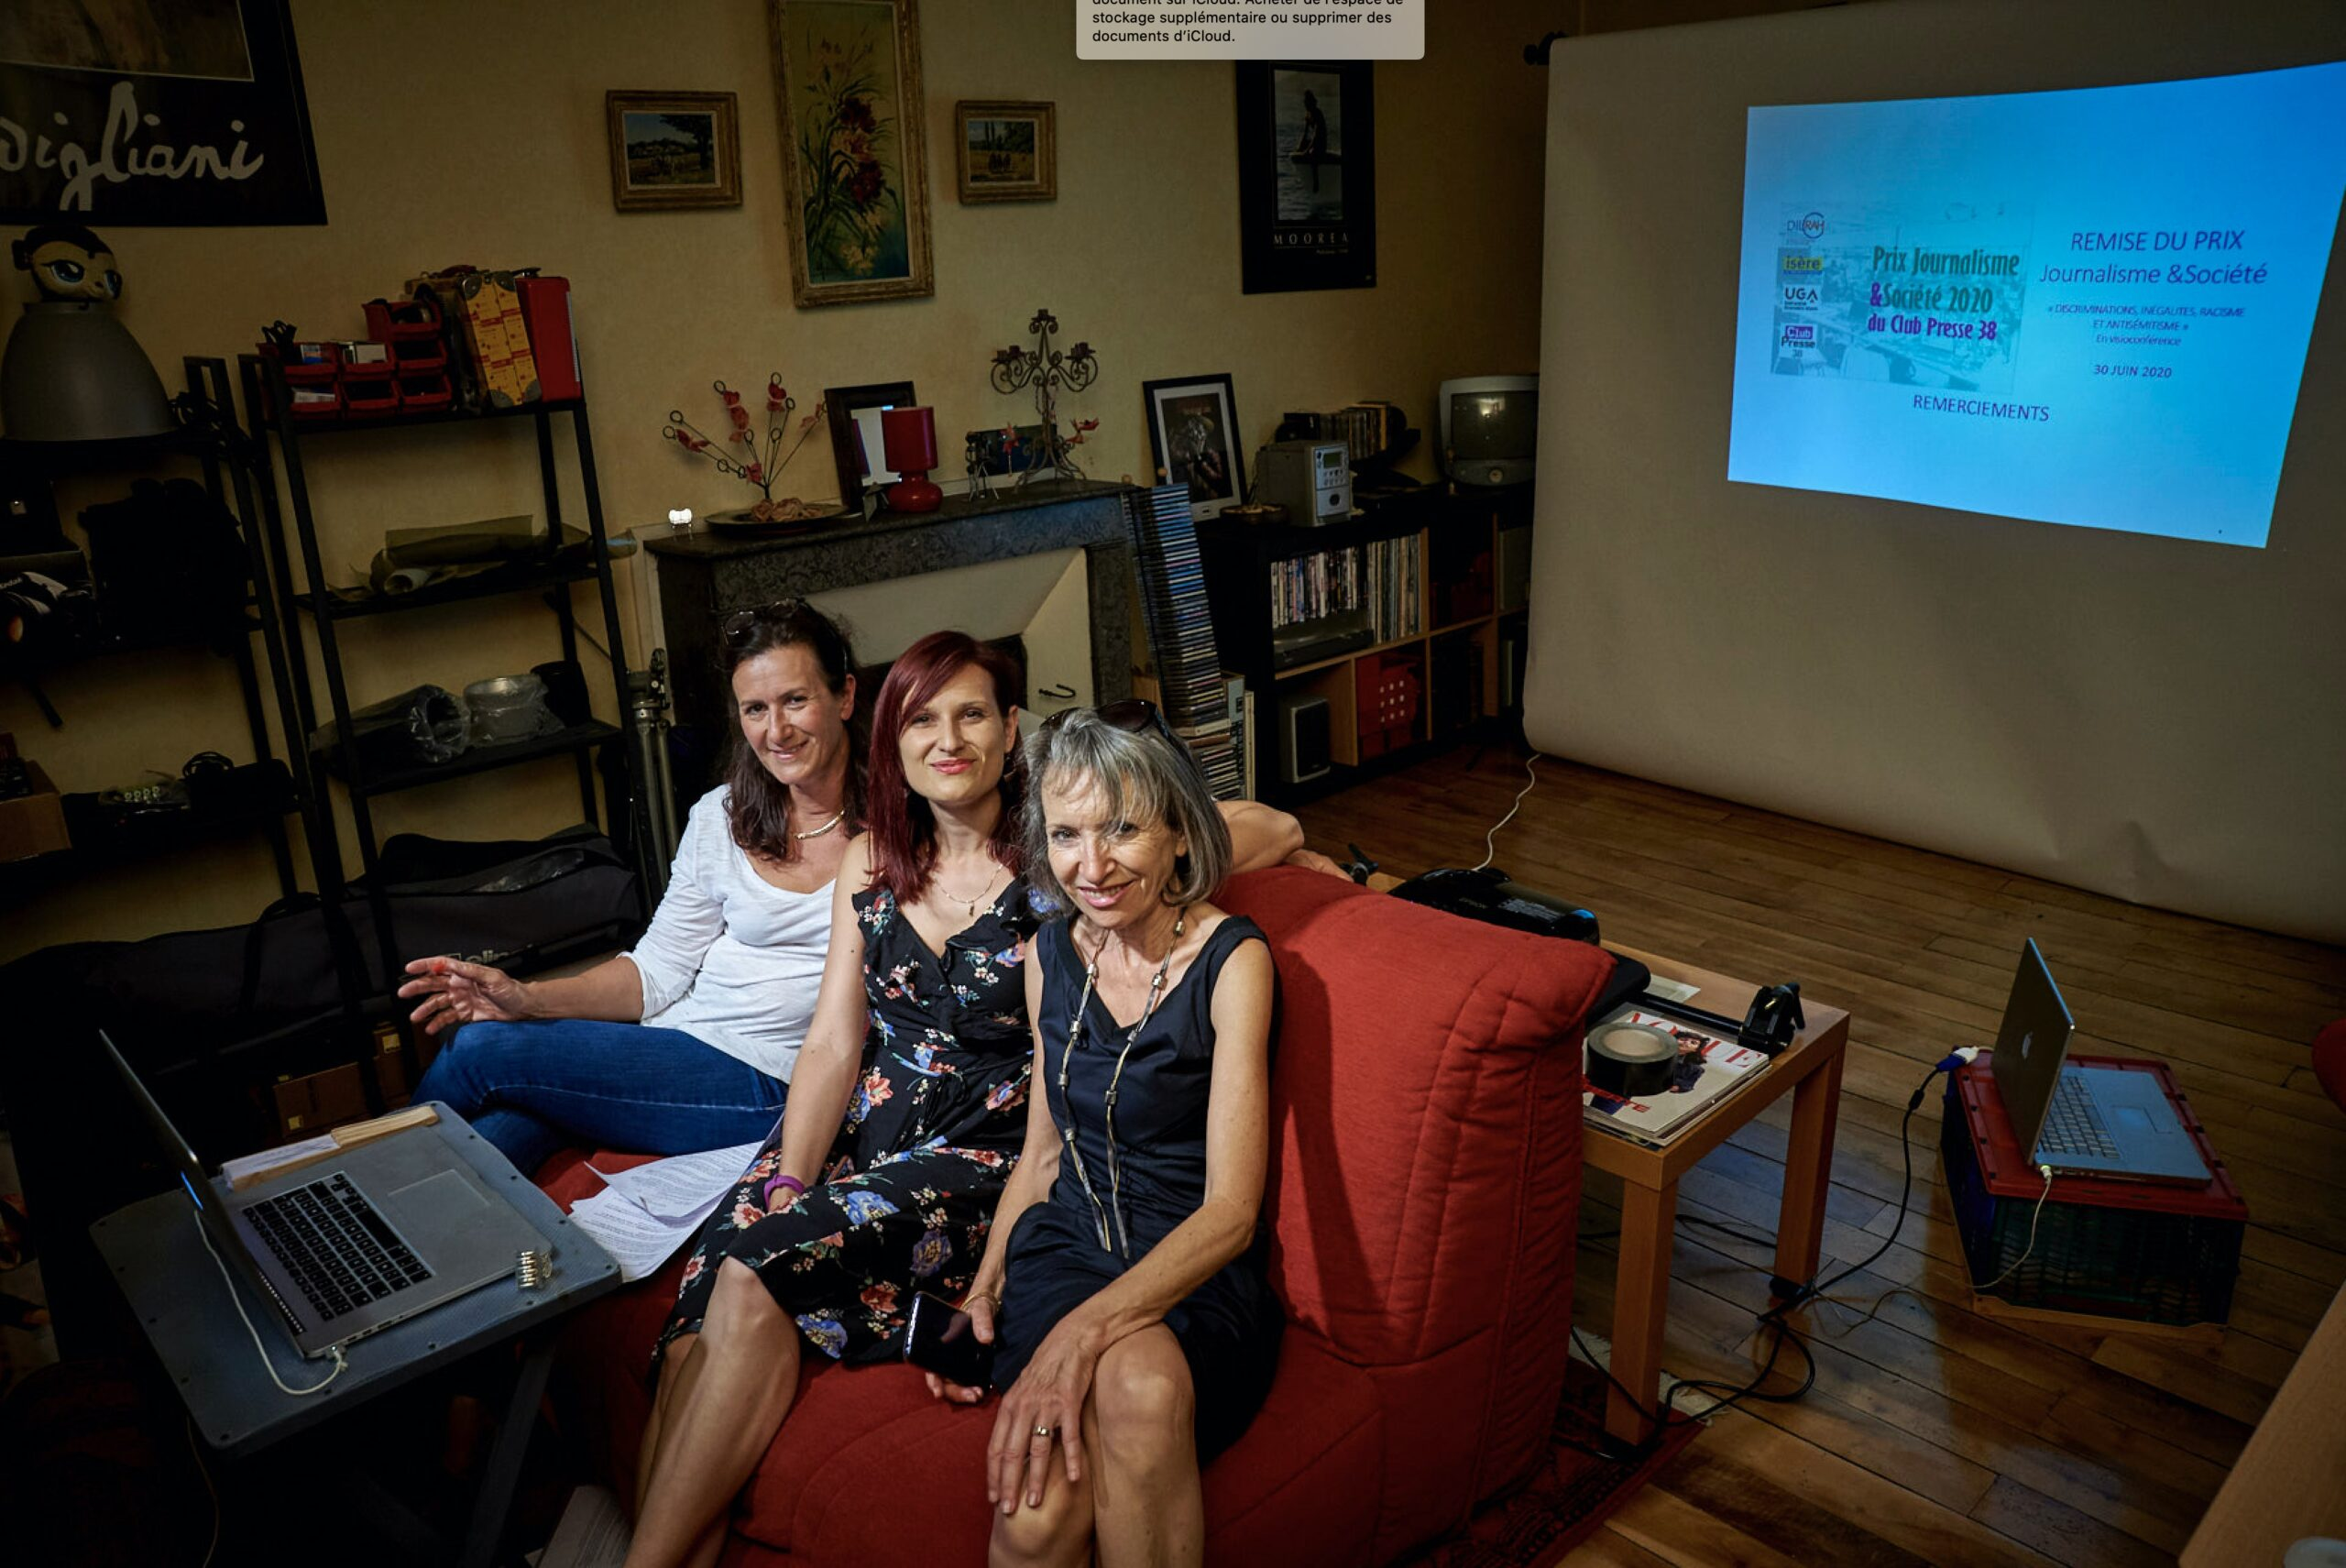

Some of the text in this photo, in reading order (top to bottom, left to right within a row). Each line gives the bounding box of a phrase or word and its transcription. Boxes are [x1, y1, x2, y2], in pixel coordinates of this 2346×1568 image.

[2071, 230, 2245, 251] REMISE DU PRIX
[1873, 245, 2020, 276] Prix Journalisme
[2040, 262, 2268, 285] Journalisme &Société
[1785, 287, 1818, 301] UGA
[1870, 281, 1993, 313] &Société 2020
[1868, 313, 1997, 340] du Club Presse 38
[2093, 320, 2104, 329] ET
[2096, 334, 2106, 344] En
[2093, 365, 2172, 378] 30 JUIN 2020
[1913, 394, 2051, 422] REMERCIEMENTS
